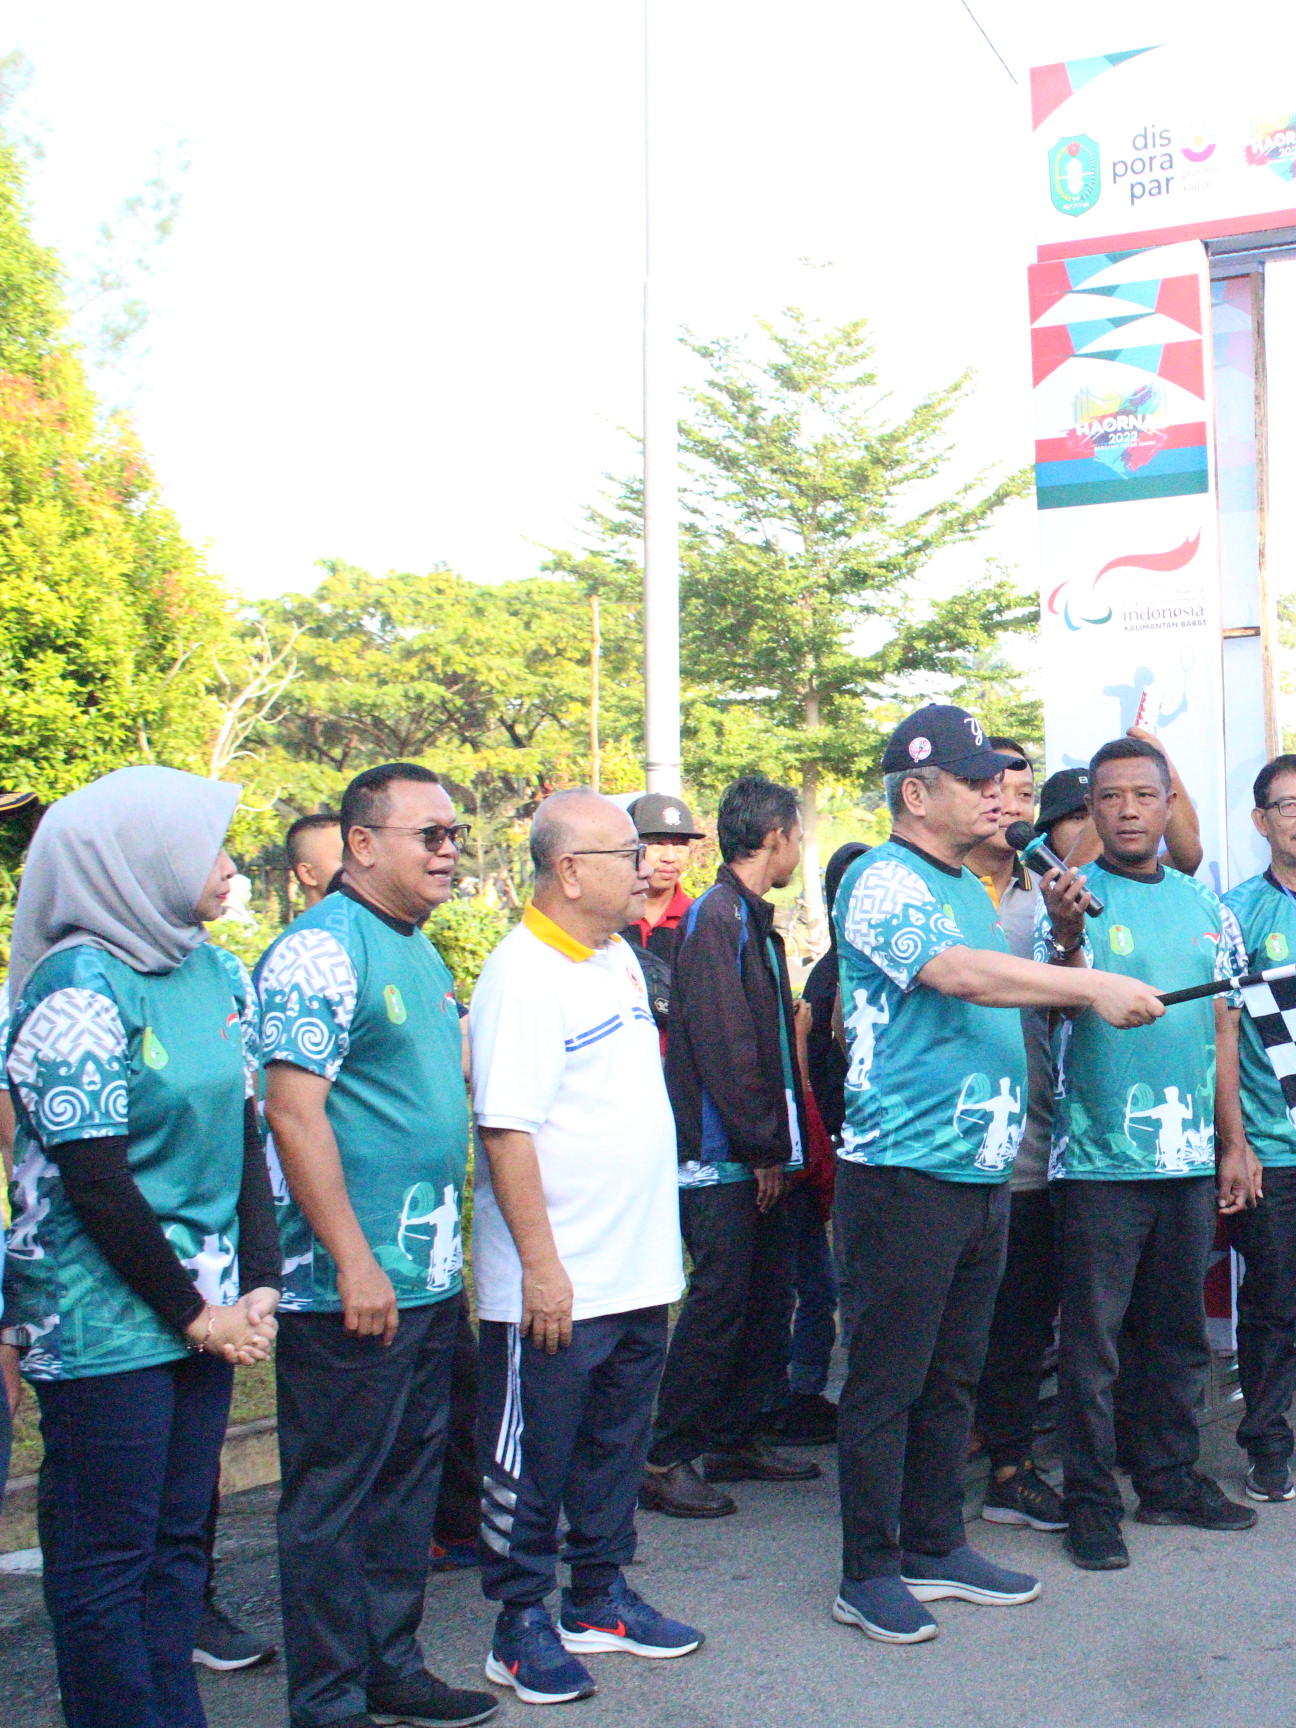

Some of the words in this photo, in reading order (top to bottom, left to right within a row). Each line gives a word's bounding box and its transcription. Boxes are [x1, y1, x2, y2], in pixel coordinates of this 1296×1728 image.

[1132, 124, 1172, 151] dis
[1112, 152, 1174, 184] pora
[1130, 176, 1175, 206] par
[1075, 413, 1162, 436] HAORNA
[1109, 431, 1138, 444] 2022
[1124, 622, 1178, 632] KALIMANTAN
[1181, 619, 1206, 628] BARAT
